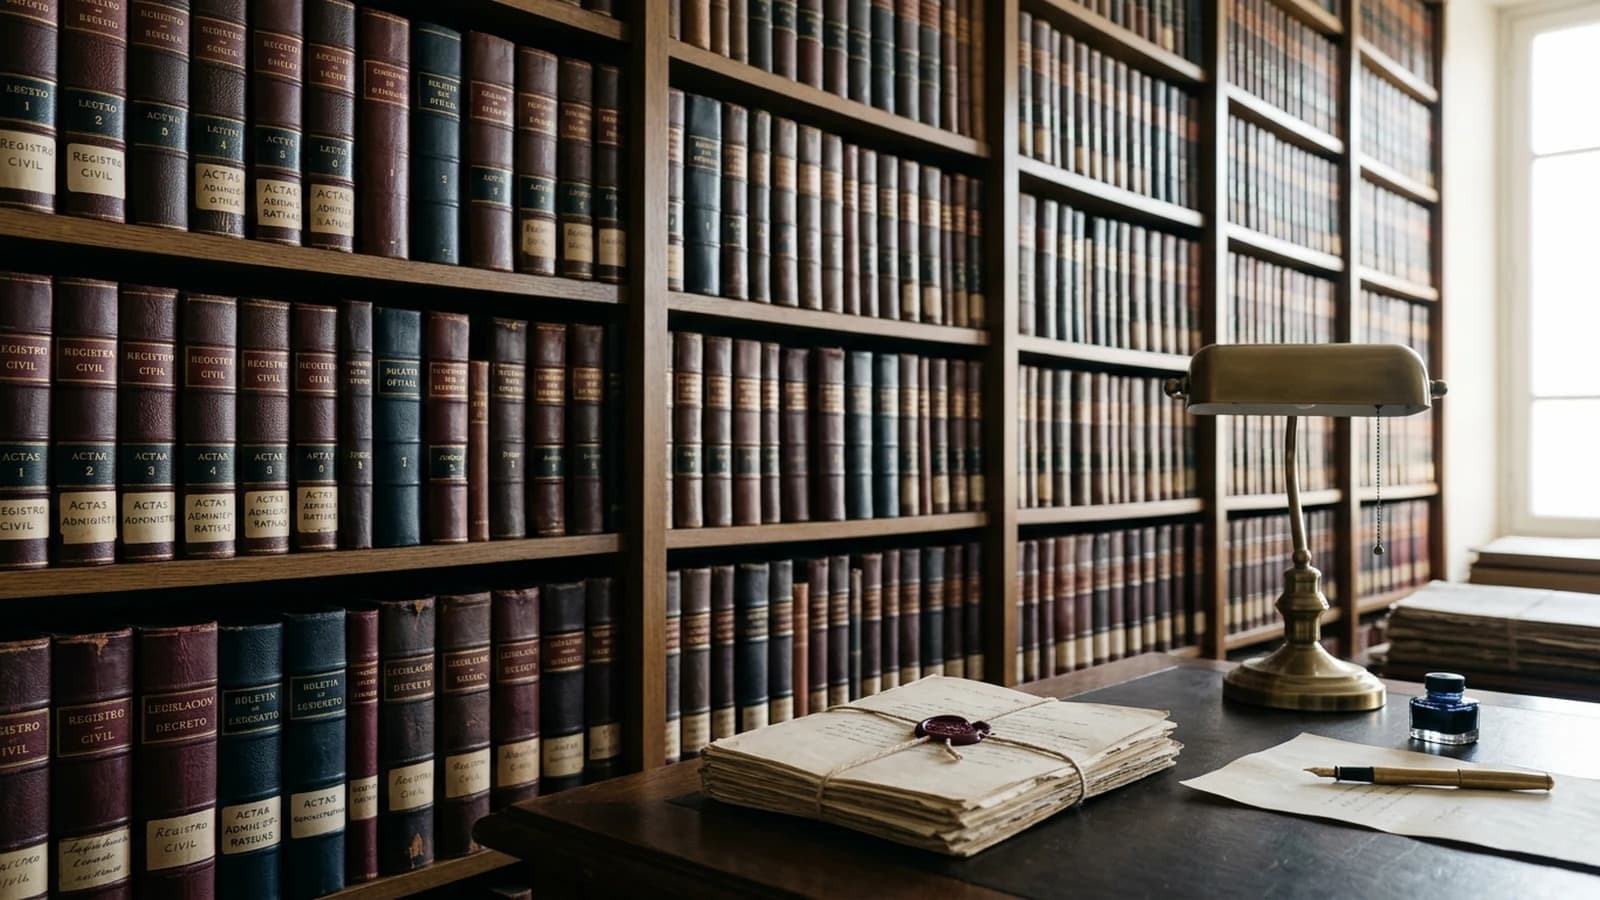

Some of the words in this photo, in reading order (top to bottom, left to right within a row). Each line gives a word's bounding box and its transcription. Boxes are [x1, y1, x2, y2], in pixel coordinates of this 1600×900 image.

[24, 101, 31, 111] 1
[95, 115, 103, 126] 2
[0, 138, 54, 157] REGISTRO
[220, 140, 228, 150] 4
[8, 156, 44, 171] CIVIL
[80, 168, 114, 181] CIVIL
[202, 169, 242, 184] ACTAS
[6, 360, 38, 371] CIVIL
[75, 363, 105, 373] CIVIL
[2, 452, 42, 462] ACTAS
[17, 467, 24, 478] 1
[85, 466, 95, 477] 2
[148, 466, 156, 476] 3
[209, 466, 217, 476] 4
[68, 500, 108, 511] ACTAS
[133, 500, 169, 511] ACTAS
[0, 522, 34, 531] CIVIL
[155, 717, 207, 734] DECRETO
[303, 794, 338, 808] ACTAS
[163, 840, 198, 854] CIVIL
